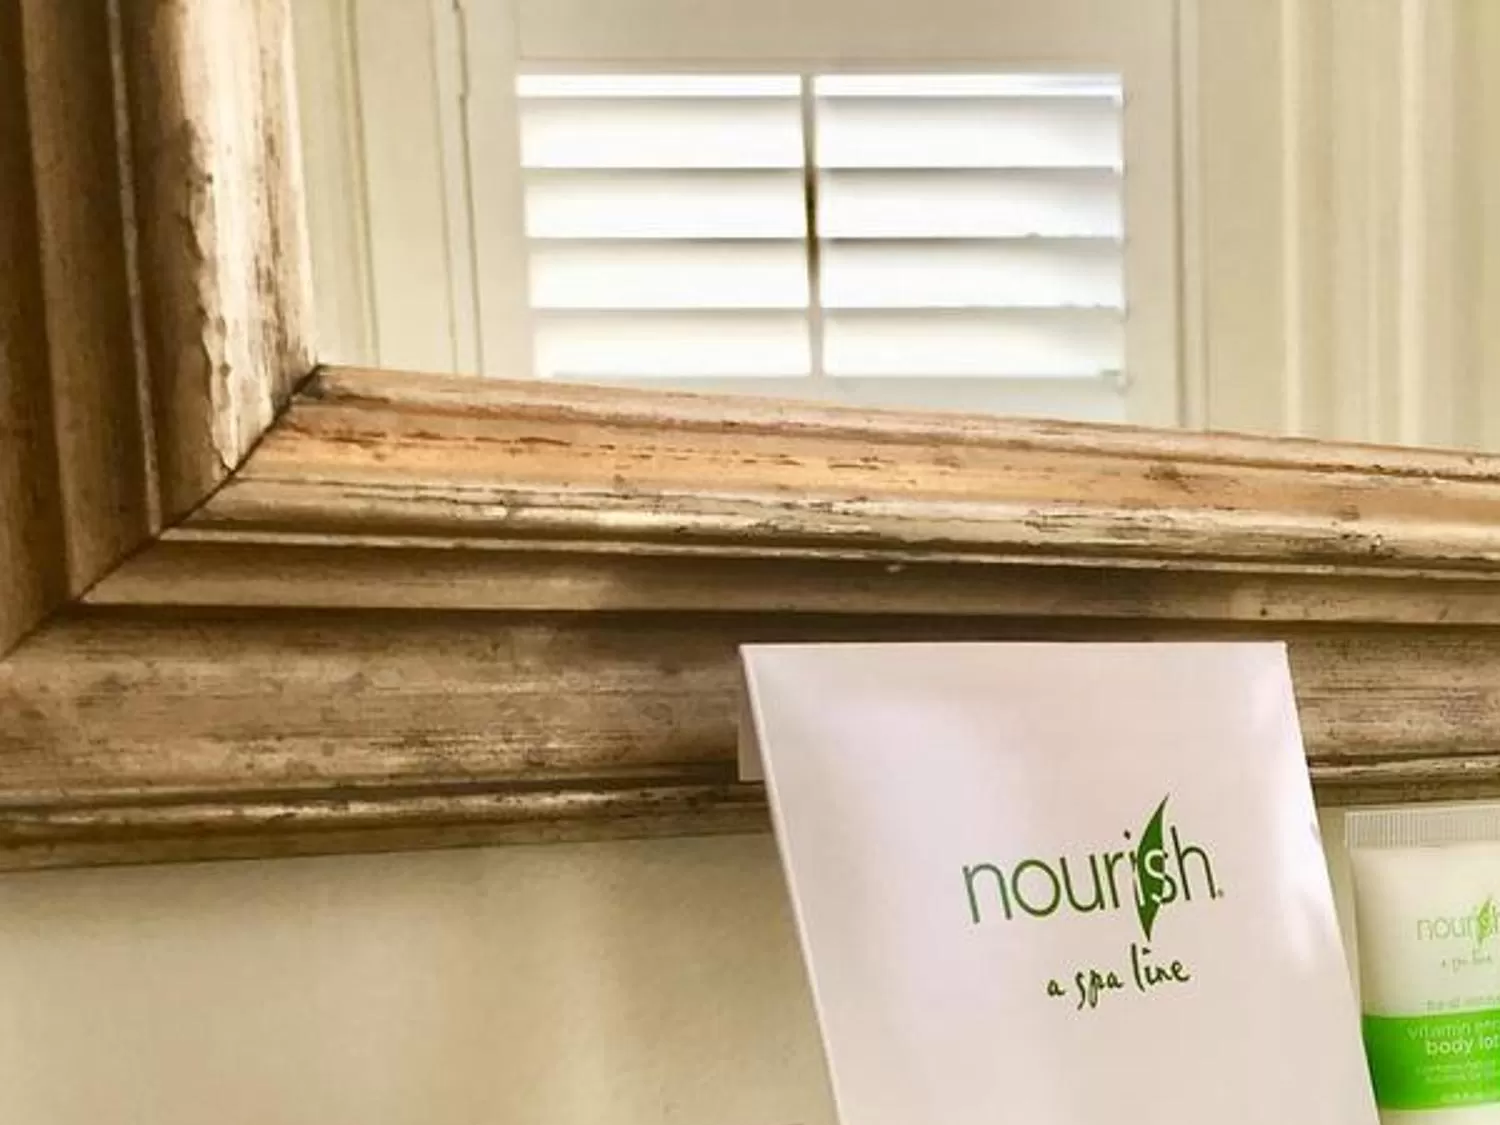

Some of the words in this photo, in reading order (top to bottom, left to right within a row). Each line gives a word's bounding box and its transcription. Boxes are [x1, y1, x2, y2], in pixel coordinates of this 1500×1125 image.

[961, 812, 1218, 930] nourish
[1046, 978, 1066, 997] a
[1074, 967, 1125, 1011] spa
[1130, 942, 1191, 993] line
[1426, 1036, 1475, 1057] body
